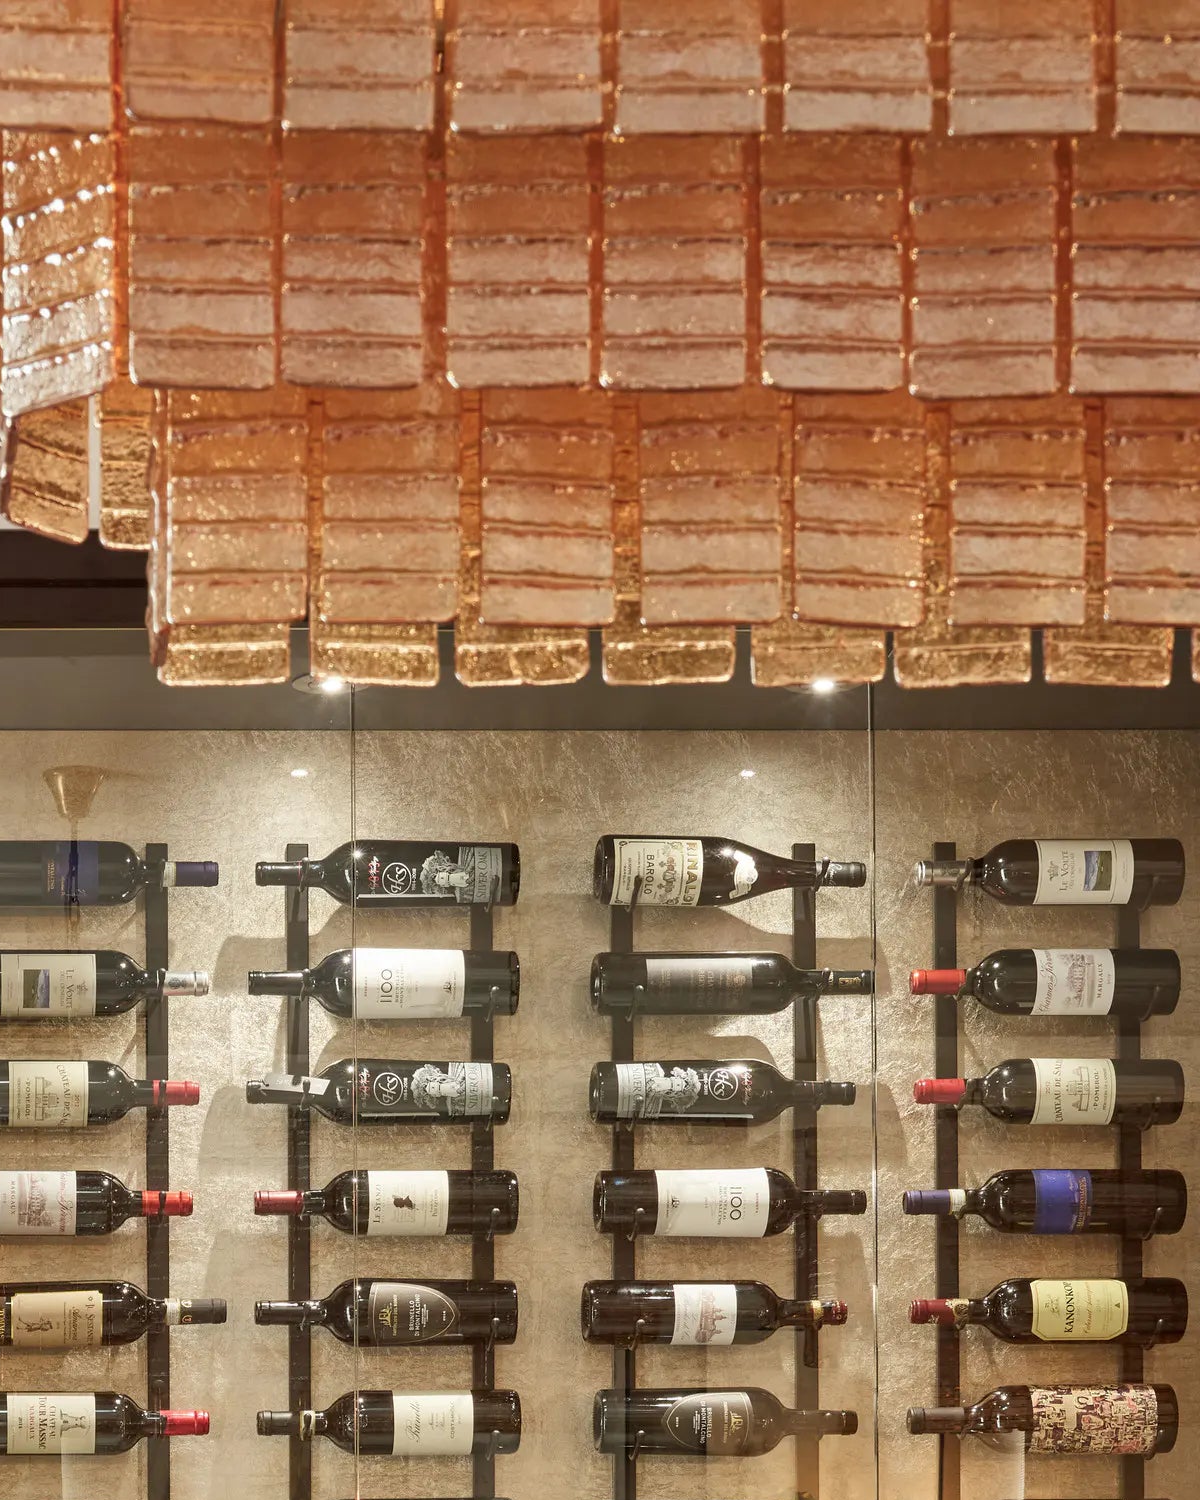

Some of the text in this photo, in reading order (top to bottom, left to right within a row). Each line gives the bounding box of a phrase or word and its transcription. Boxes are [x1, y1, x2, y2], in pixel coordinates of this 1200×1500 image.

[478, 851, 487, 898] SILVER OAK
[644, 855, 654, 894] BAROLO
[1060, 881, 1068, 890] LE
[66, 970, 74, 1008] LE VOLTE
[380, 969, 392, 1002] 1100
[469, 1082, 478, 1108] SILVER
[632, 1068, 642, 1092] SILVER
[1055, 1078, 1060, 1087] DE
[64, 1101, 70, 1111] DE
[374, 1214, 380, 1223] LE
[730, 1187, 742, 1220] 1100
[1063, 1282, 1074, 1332] KANONKOP
[39, 1418, 48, 1449] MASSAC
